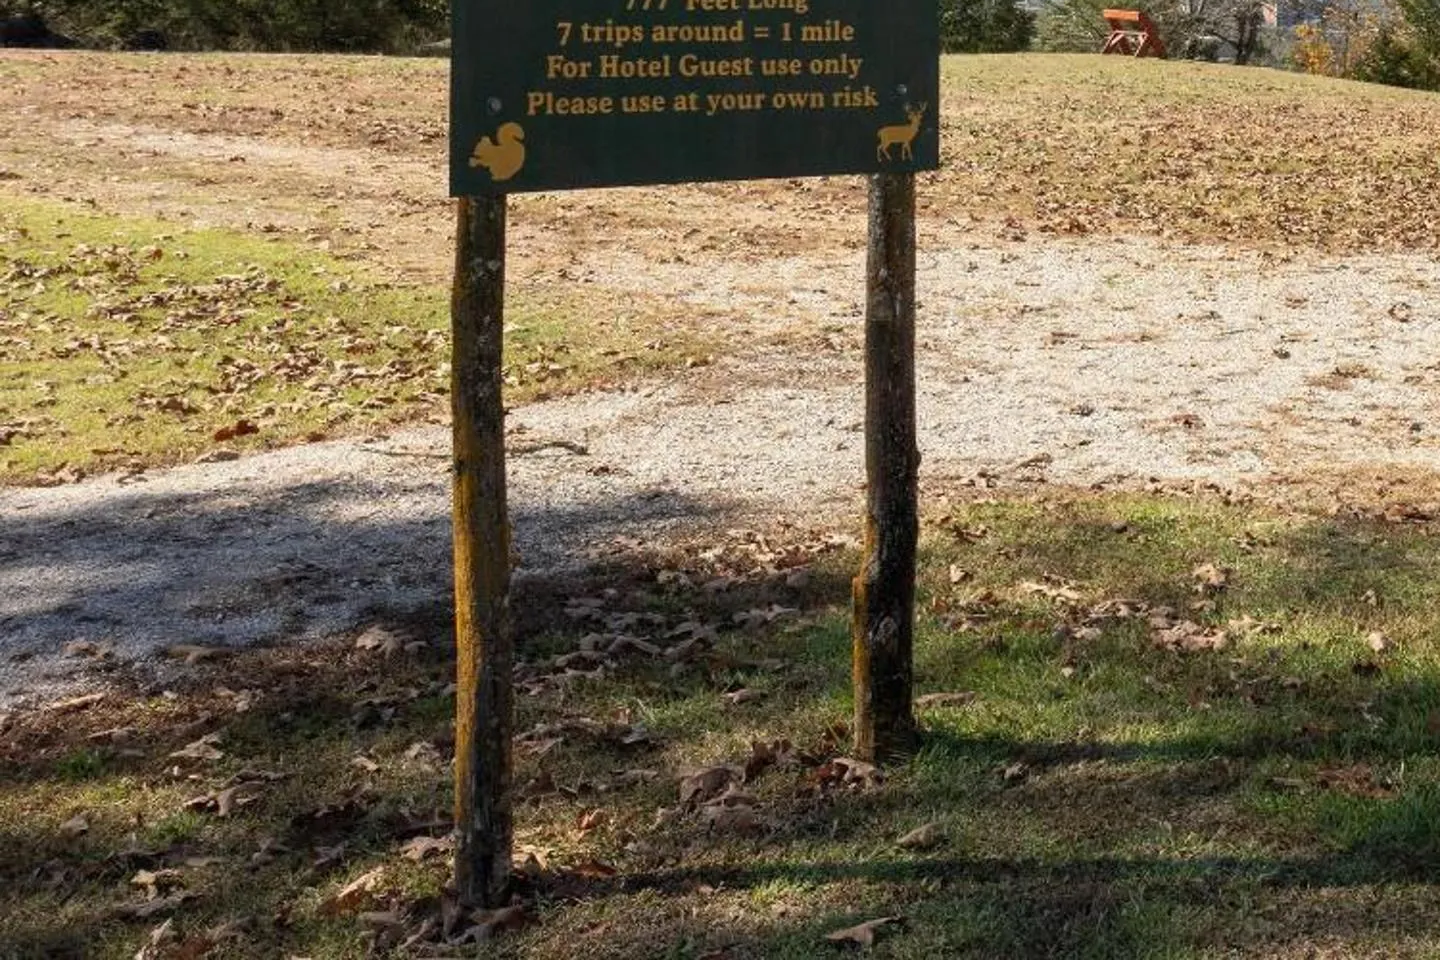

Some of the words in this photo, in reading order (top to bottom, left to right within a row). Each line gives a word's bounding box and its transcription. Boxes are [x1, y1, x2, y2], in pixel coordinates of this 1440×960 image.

[558, 22, 573, 45] 7
[581, 20, 644, 47] trips
[652, 20, 744, 42] around
[755, 26, 769, 38] =
[781, 22, 792, 41] 1
[801, 20, 854, 41] mile
[547, 55, 591, 78] For
[600, 55, 670, 77] Hotel
[679, 55, 753, 77] Guest
[761, 59, 802, 75] use
[809, 54, 863, 78] only
[527, 92, 612, 115] Please
[622, 95, 665, 113] use
[673, 93, 699, 111] at
[707, 93, 765, 116] your
[773, 92, 824, 109] own
[833, 85, 879, 108] risk
